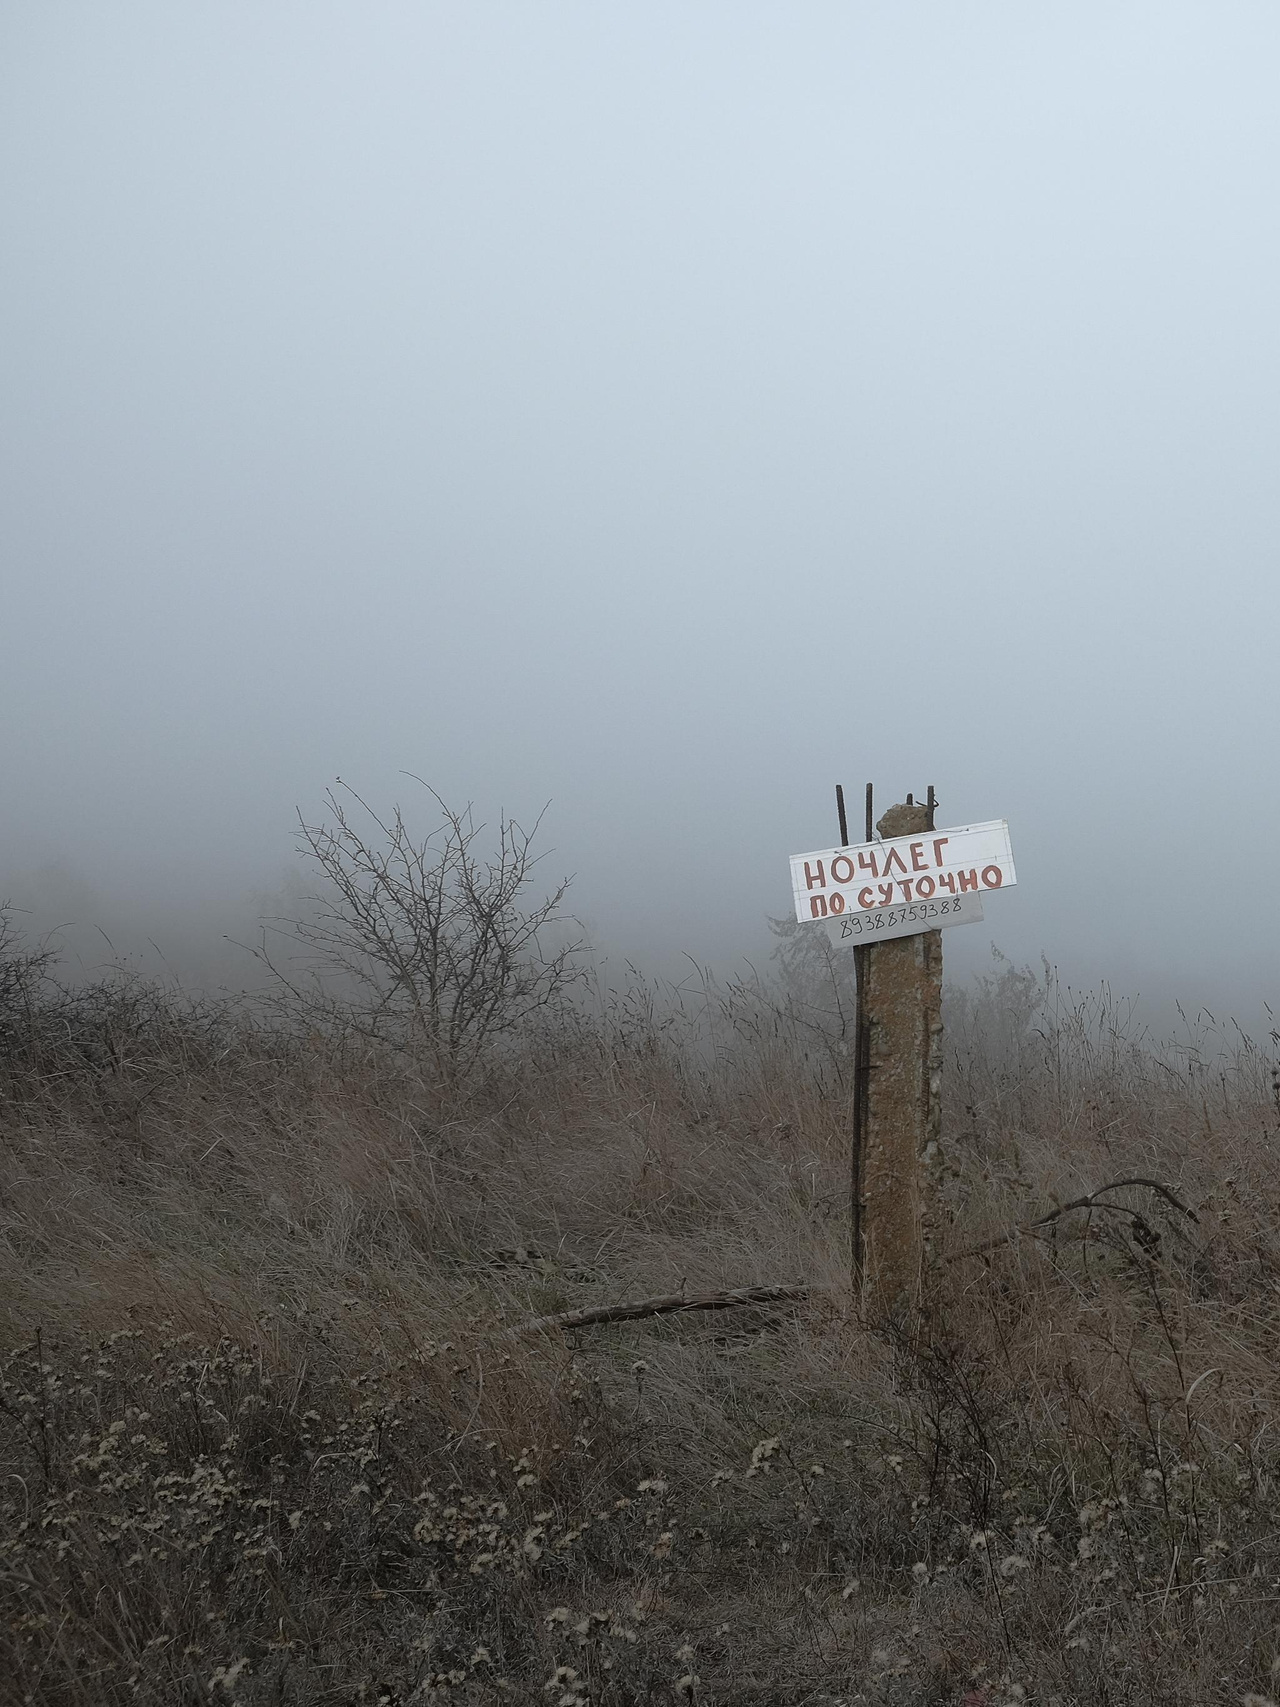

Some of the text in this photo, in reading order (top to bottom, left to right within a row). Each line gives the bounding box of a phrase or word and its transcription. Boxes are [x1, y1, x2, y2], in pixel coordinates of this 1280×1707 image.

[804, 838, 949, 890] НОЧЛЕГ
[810, 865, 1003, 918] ПО СУТОЧНО
[840, 898, 962, 939] 89388759388
